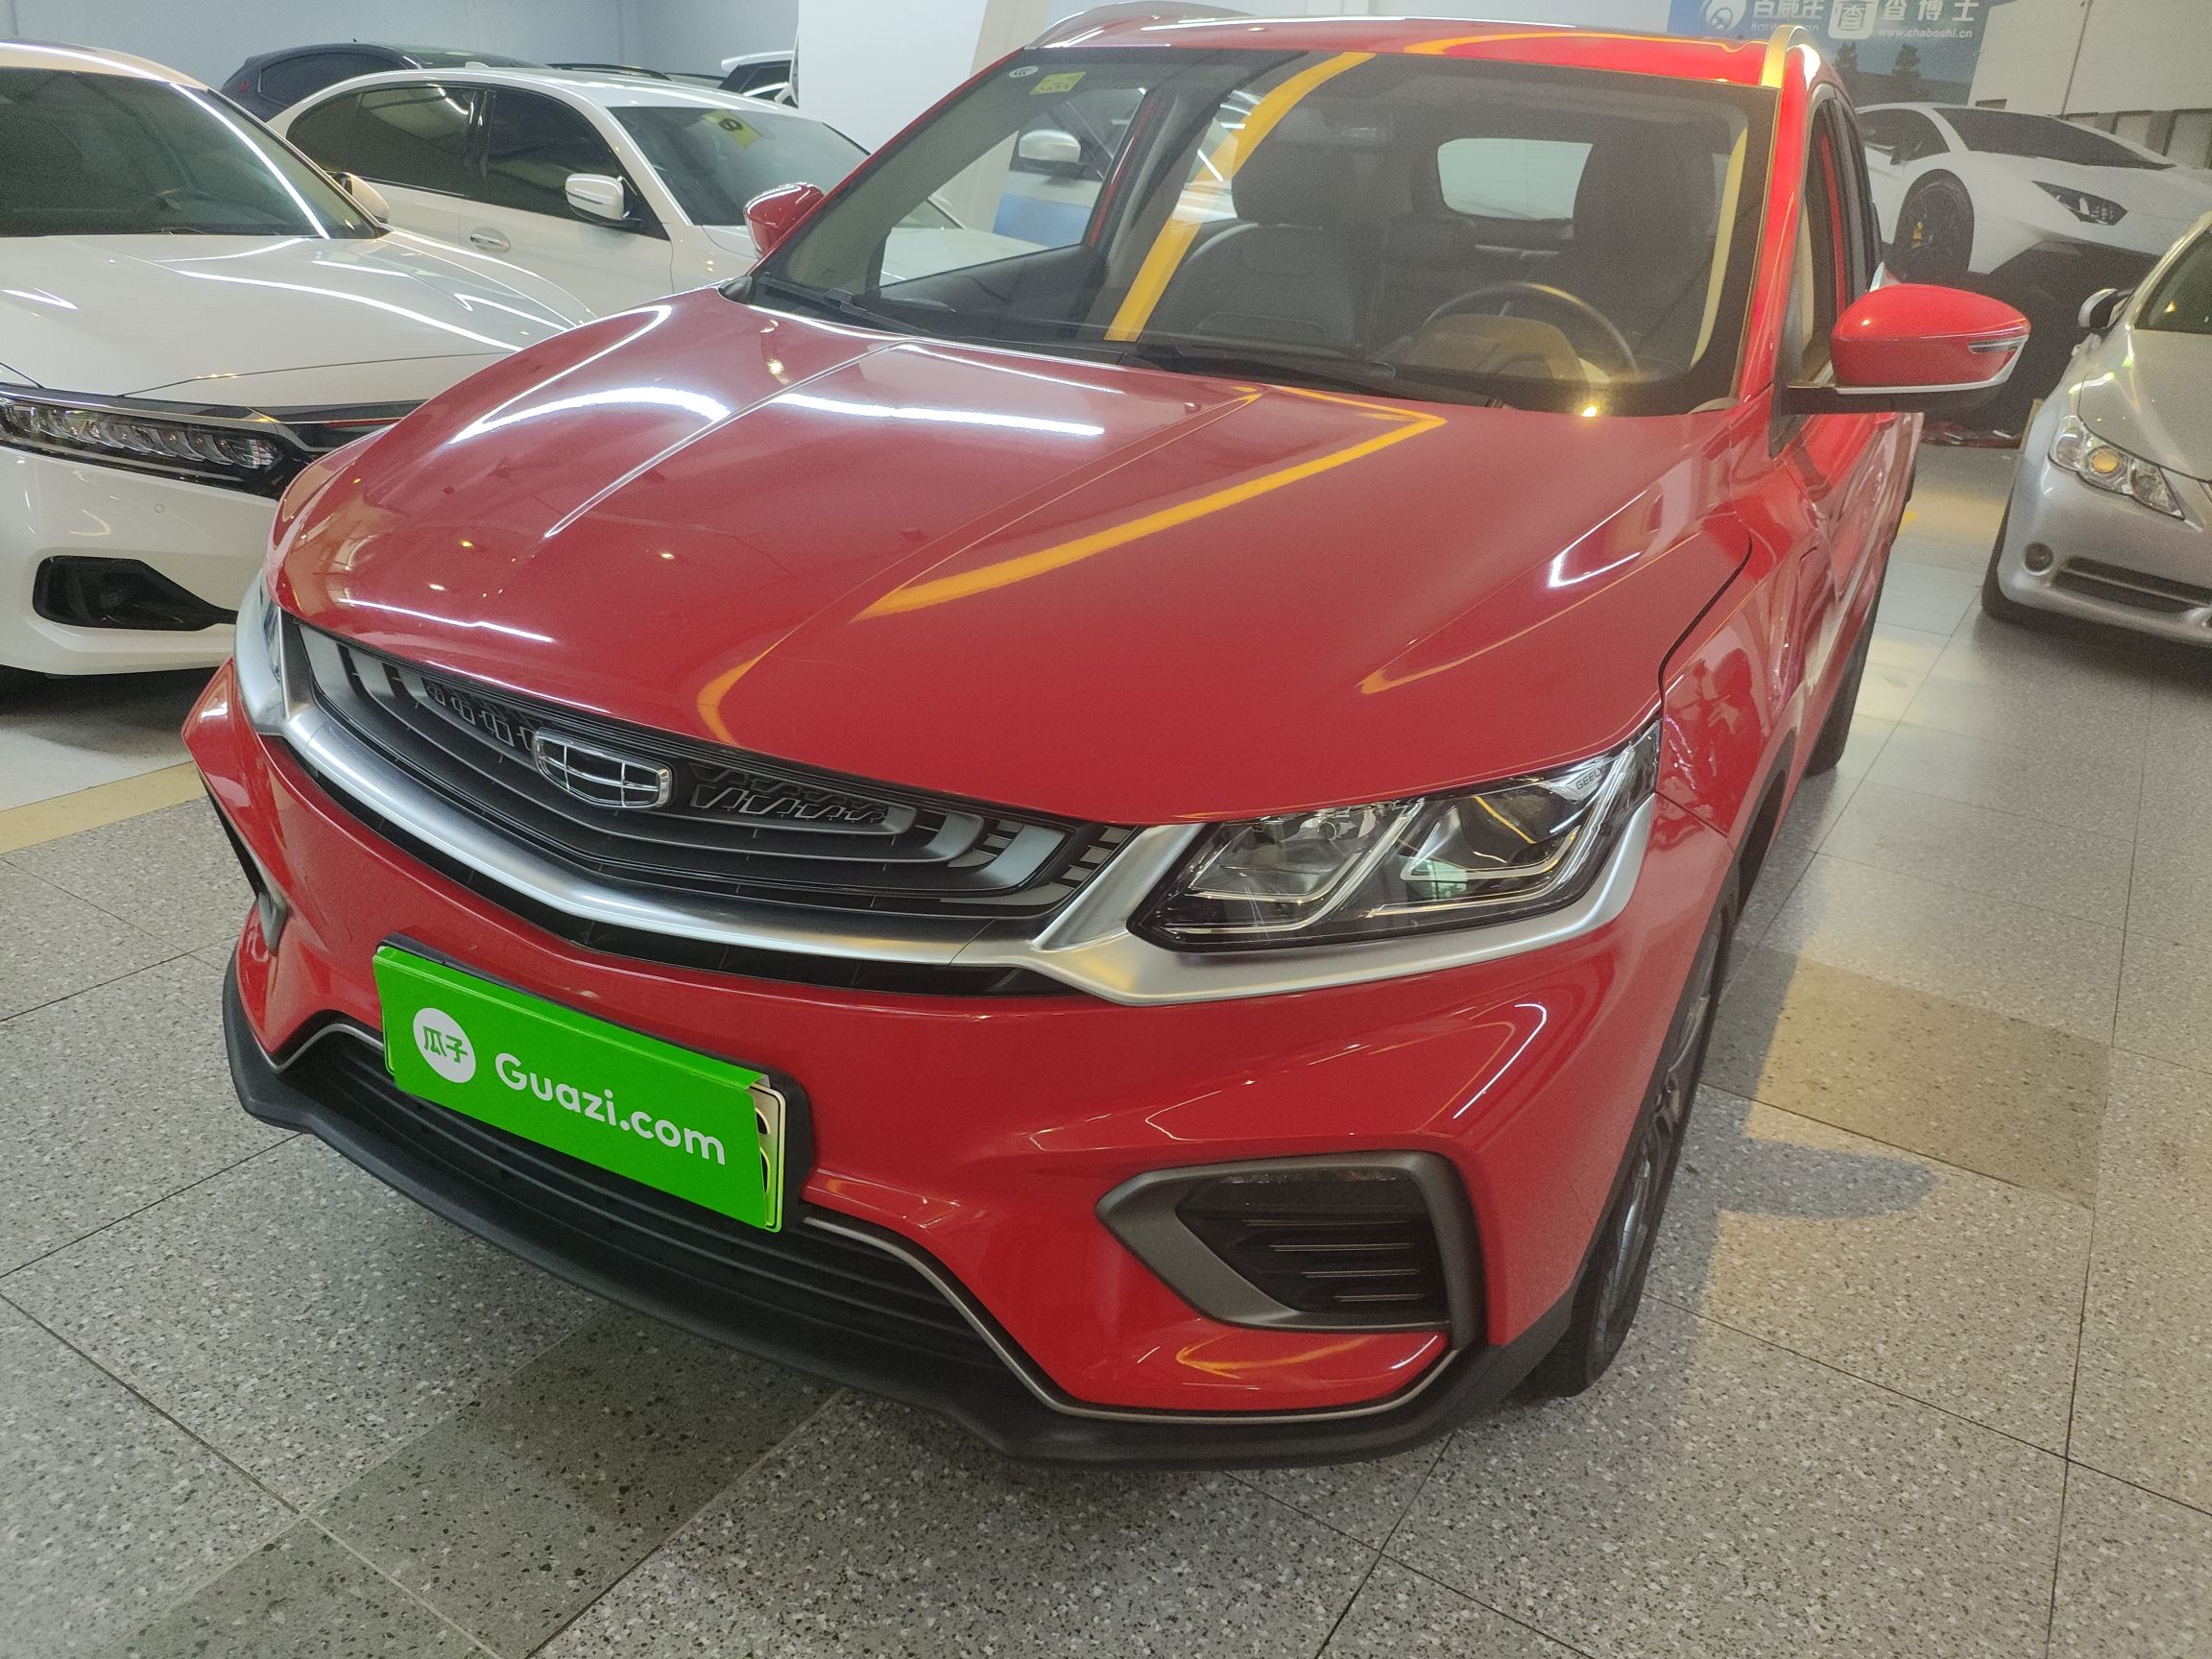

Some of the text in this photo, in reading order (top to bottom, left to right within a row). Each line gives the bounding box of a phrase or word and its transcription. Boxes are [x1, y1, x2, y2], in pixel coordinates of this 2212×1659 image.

[1878, 27, 1973, 39] www.chaboshi.cn
[1575, 767, 1602, 790] GEELY
[422, 1024, 469, 1064] 瓜子
[494, 1052, 726, 1166] Guazi.com
